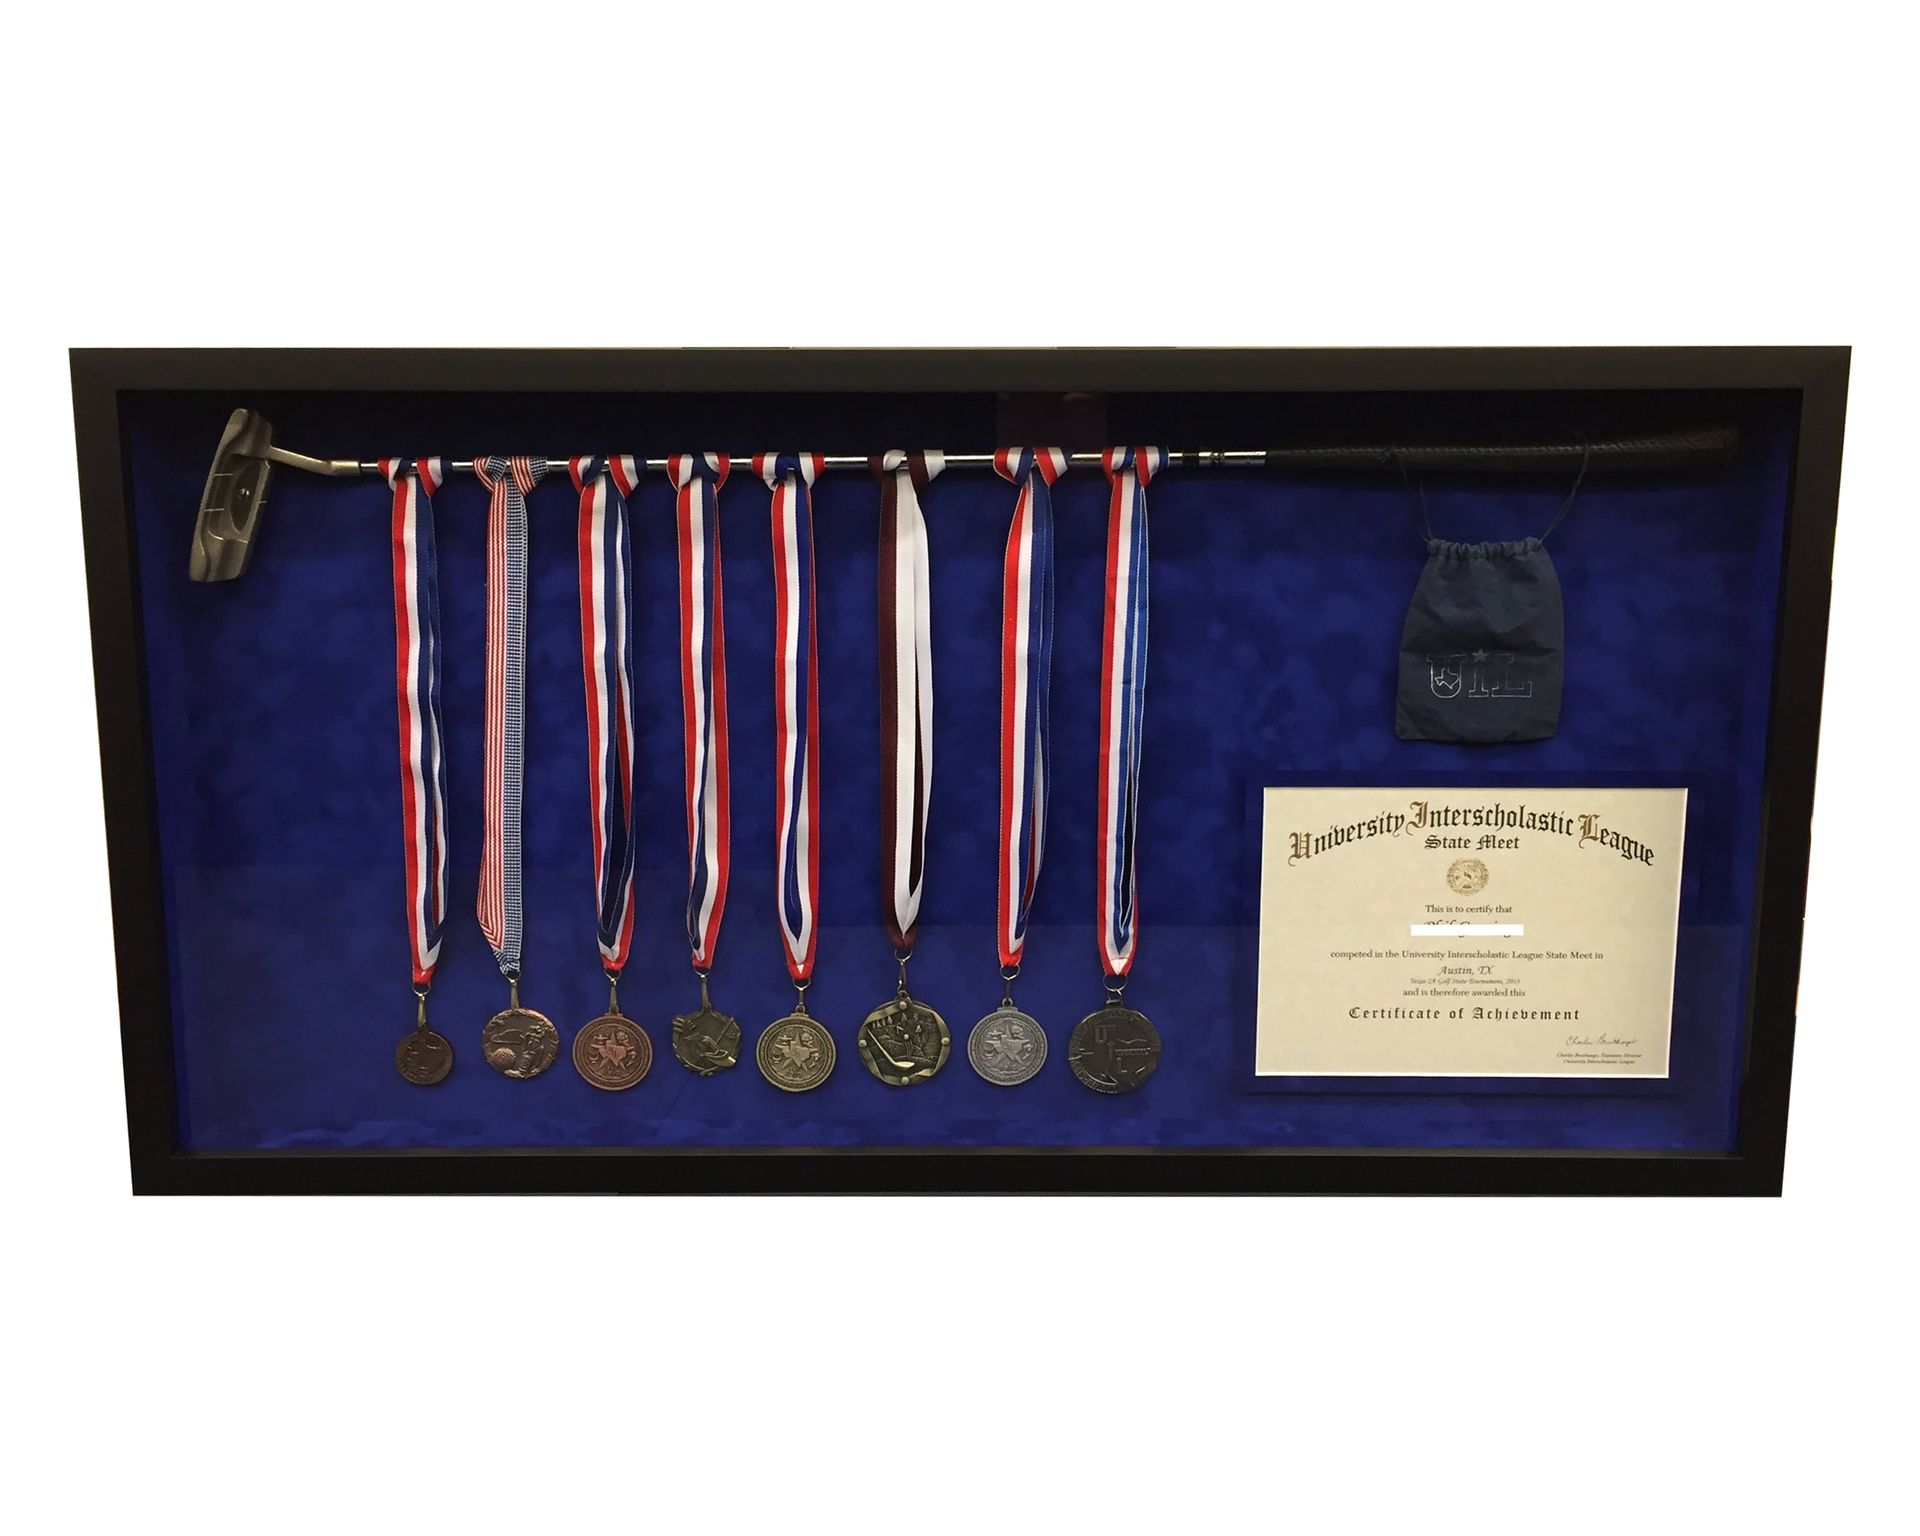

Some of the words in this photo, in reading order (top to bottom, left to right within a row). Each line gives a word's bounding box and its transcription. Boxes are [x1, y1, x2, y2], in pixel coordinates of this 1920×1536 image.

[1288, 810, 1405, 867] University
[1406, 801, 1574, 836] Interscholastic
[1578, 813, 1654, 866] League
[1424, 834, 1471, 849] State
[1476, 834, 1520, 850] Meet
[1425, 904, 1444, 913] This
[1446, 905, 1453, 913] is
[1455, 905, 1464, 913] to
[1466, 904, 1493, 915] certify
[1495, 905, 1512, 913] that
[1330, 950, 1373, 960] competed
[1385, 950, 1400, 958] the
[1401, 950, 1445, 961] University
[1447, 950, 1509, 959] Interscholastic
[1512, 950, 1544, 961] League
[1546, 951, 1568, 959] State
[1570, 951, 1593, 959] Meet
[1595, 951, 1604, 959] in
[1437, 965, 1474, 976] Austin,
[1477, 965, 1495, 975] TX
[1403, 988, 1419, 996] and
[1430, 988, 1470, 996] therefore
[1471, 988, 1508, 997] awarded
[1510, 988, 1526, 997] this
[1349, 1007, 1441, 1019] Certificate
[1449, 1008, 1464, 1019] of
[1472, 1007, 1580, 1021] Achievement
